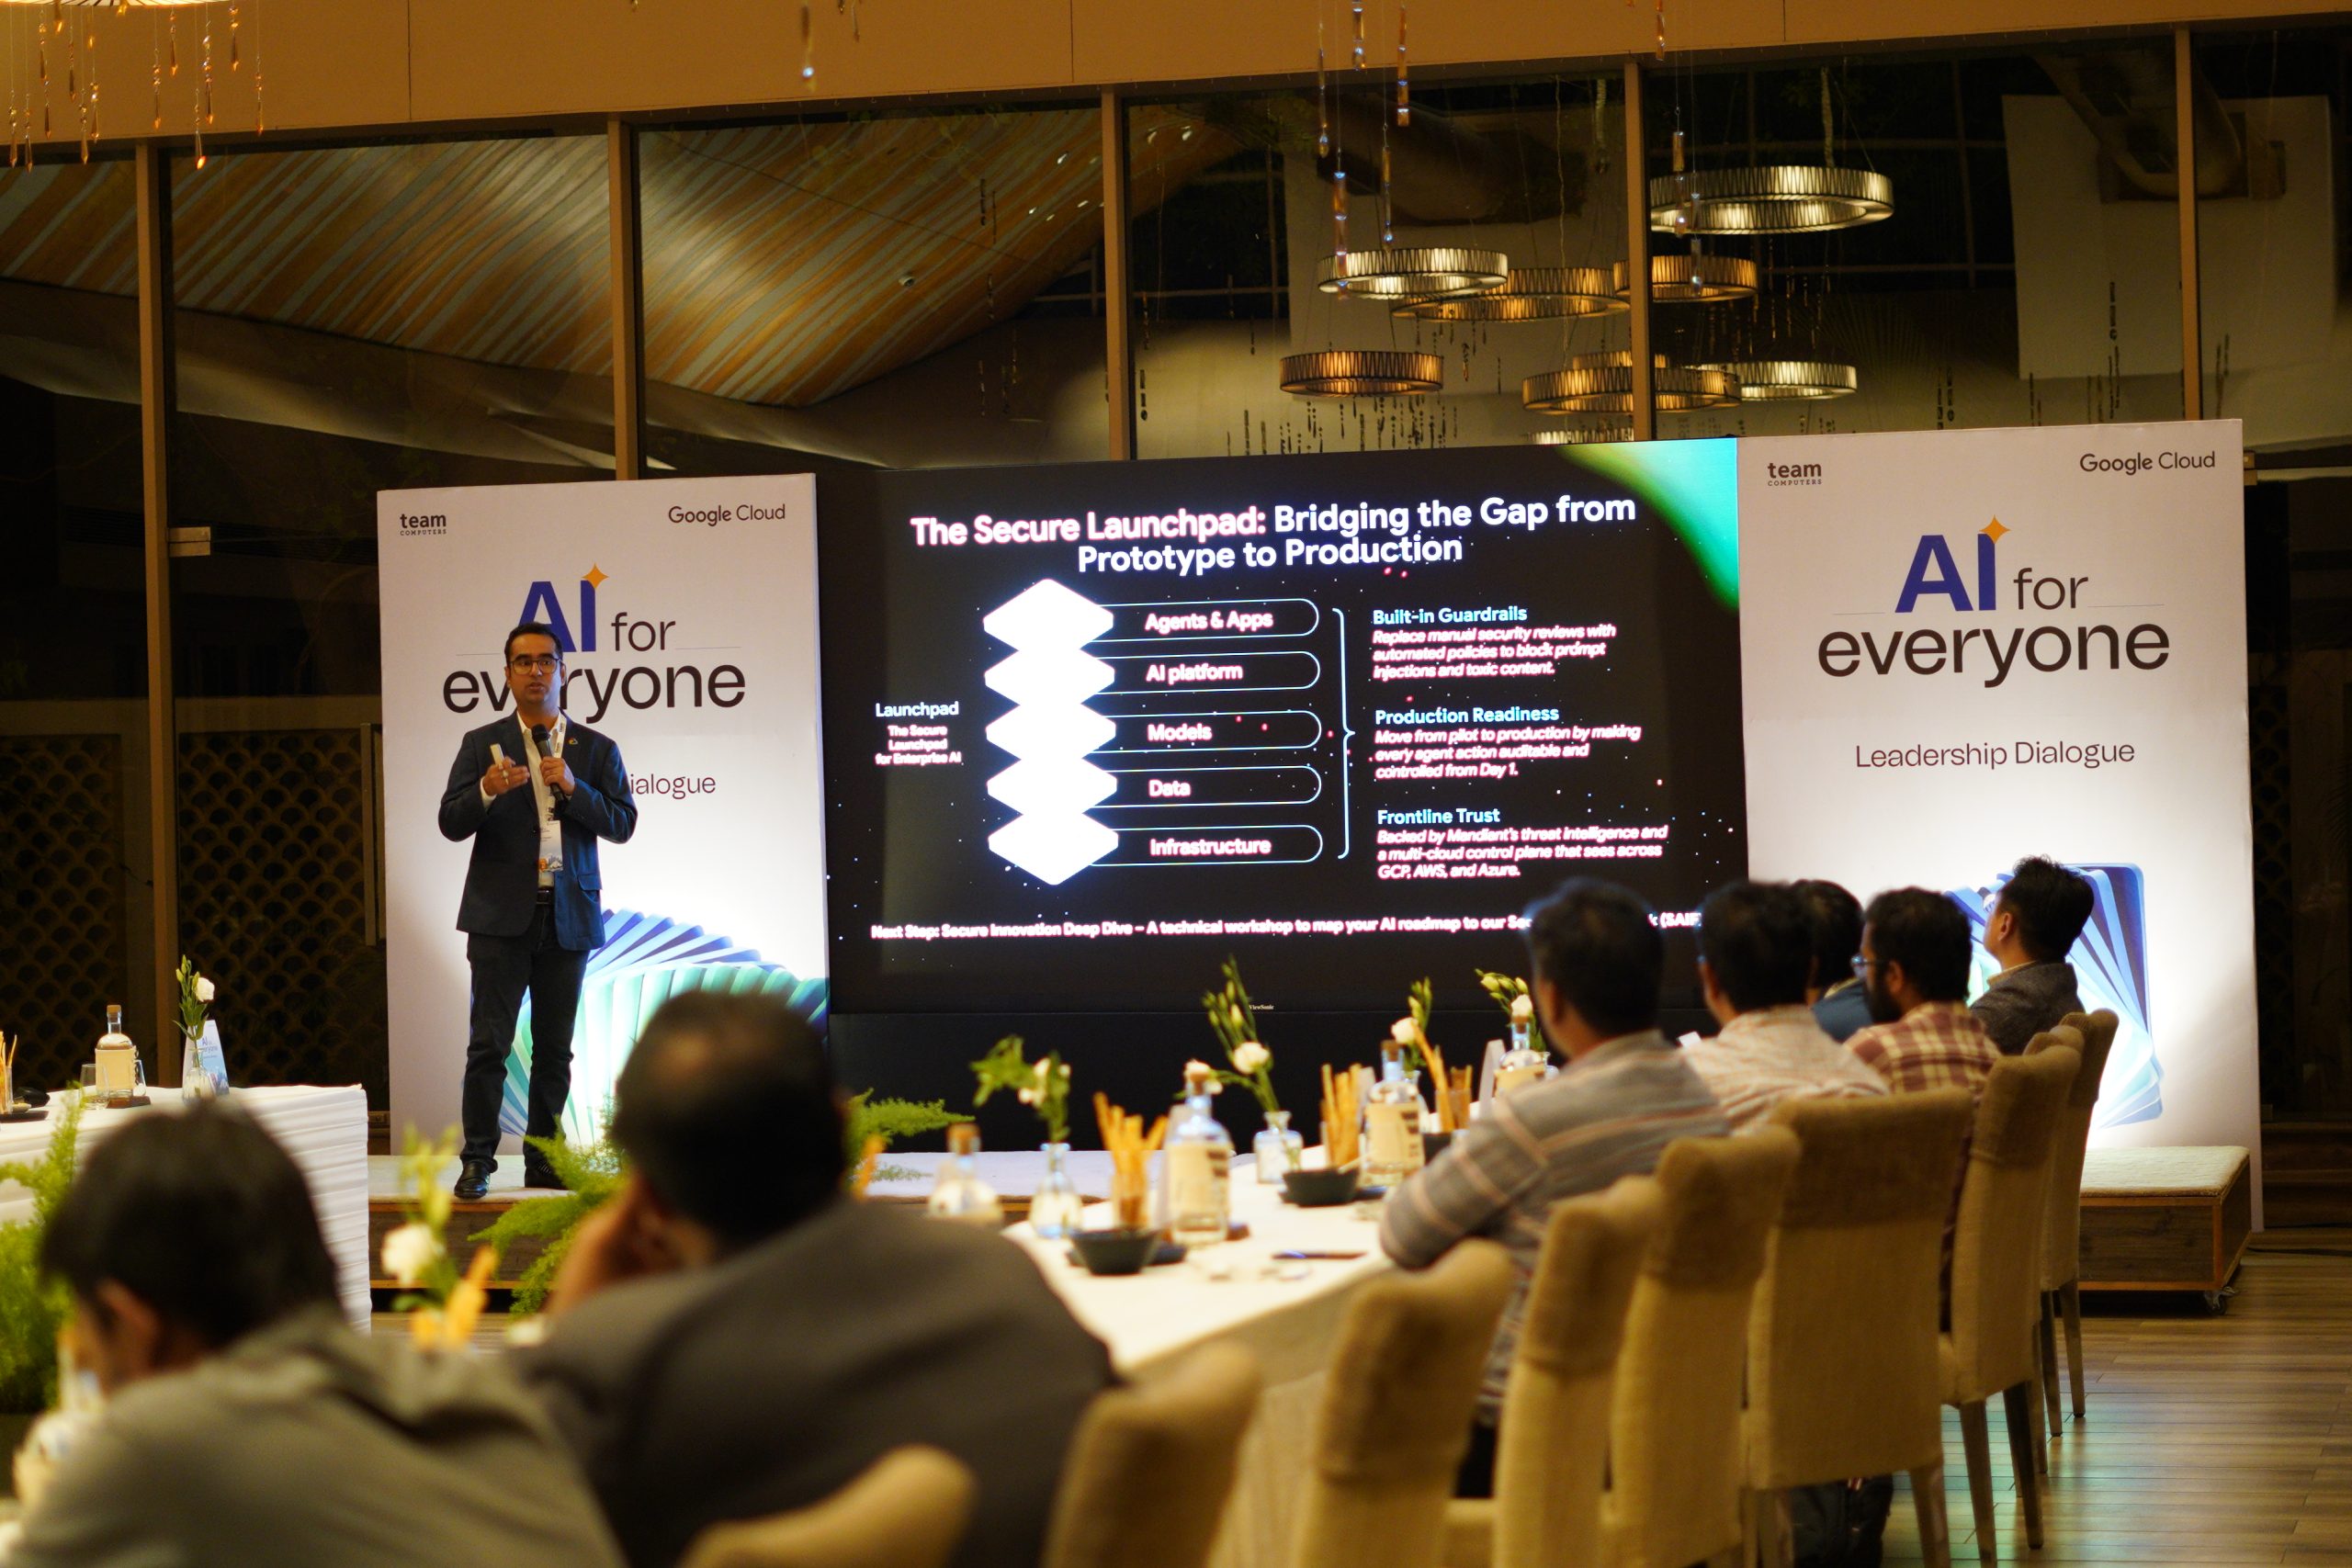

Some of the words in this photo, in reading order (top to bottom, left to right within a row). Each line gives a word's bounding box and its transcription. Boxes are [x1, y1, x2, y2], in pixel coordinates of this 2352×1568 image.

[1768, 462, 1822, 479] team
[2079, 453, 2154, 476] Google
[2158, 450, 2216, 470] Cloud
[1768, 479, 1822, 487] COMPUTERS
[400, 513, 447, 529] team
[668, 505, 731, 526] Google
[736, 503, 786, 522] Cloud
[910, 516, 970, 544] The
[974, 513, 1080, 544] Secure
[1087, 508, 1267, 544] Launchpad:
[1274, 502, 1409, 536] Bridging
[1418, 500, 1472, 527] the
[1480, 497, 1548, 531] Gap
[1555, 494, 1635, 523] from
[1078, 542, 1236, 576] Prototype
[1243, 544, 1277, 568] to
[1286, 532, 1463, 566] Production
[1894, 533, 1996, 614] AI
[2013, 567, 2088, 610] for
[518, 580, 597, 653] AI
[611, 612, 676, 652] for
[1145, 613, 1208, 635] Agents
[1209, 610, 1225, 629] &
[1226, 610, 1274, 632] Apps
[1373, 609, 1435, 626] Built-in
[1438, 605, 1528, 624] Guardrails
[1373, 629, 1426, 646] Replace
[1427, 627, 1477, 642] manual
[1477, 626, 1532, 642] security
[1532, 625, 1586, 640] reviews
[1586, 624, 1617, 637] with
[1373, 646, 1446, 662] automated
[1446, 645, 1498, 662] policies
[1499, 645, 1515, 659] to
[1516, 642, 1555, 658] block
[1555, 643, 1607, 660] prompt
[1818, 622, 2169, 688] everyone
[1146, 663, 1165, 682] AI
[1167, 662, 1244, 685] platform
[1374, 664, 1436, 682] injections
[1437, 663, 1464, 678] and
[1465, 662, 1498, 676] toxic
[1499, 660, 1555, 675] content.
[443, 662, 746, 724] evryone
[876, 700, 959, 719] Launchpad
[1375, 707, 1468, 725] Production
[1473, 705, 1560, 723] Readiness
[888, 724, 909, 737] The
[910, 724, 948, 737] Secure
[1147, 723, 1213, 741] Models
[1374, 729, 1413, 744] Move
[1414, 728, 1447, 743] from
[1448, 728, 1479, 745] pilot
[1480, 728, 1496, 741] to
[1496, 726, 1571, 744] production
[1572, 725, 1590, 741] by
[1591, 724, 1642, 742] making
[875, 752, 893, 765] for
[893, 752, 948, 767] Enterprise
[948, 750, 962, 763] AI
[1375, 748, 1414, 763] every
[1414, 746, 1454, 761] agent
[1455, 745, 1498, 761] action
[1498, 743, 1561, 759] auditable
[1562, 742, 1589, 758] and
[1856, 742, 2007, 771] Leadership
[2015, 739, 2135, 769] Dialogue
[1375, 764, 1443, 780] controlled
[1444, 763, 1478, 779] from
[1479, 761, 1507, 779] Day
[630, 773, 716, 800] ialogue
[1148, 779, 1192, 797] Data
[1377, 809, 1453, 825] Frontline
[1455, 807, 1500, 824] Trust
[1376, 829, 1427, 844] Backed
[1428, 829, 1446, 845] by
[1520, 826, 1562, 841] threat
[1563, 826, 1640, 843] intelligence
[1640, 825, 1668, 840] and
[1149, 837, 1272, 856] Infrastructure
[1377, 850, 1387, 862] a
[1465, 845, 1515, 861] control
[1514, 844, 1553, 862] plane
[1555, 843, 1583, 858] that
[1583, 844, 1617, 858] sees
[1617, 844, 1663, 858] across
[1449, 863, 1479, 878] and
[871, 924, 904, 939] Next
[941, 924, 989, 938] Secure
[989, 922, 1062, 937] Innovation
[1063, 921, 1101, 938] Deep
[1102, 921, 1134, 936] Dive
[1146, 920, 1159, 935] A
[1159, 920, 1223, 935] technical
[1224, 919, 1294, 936] workshop
[1295, 919, 1311, 933] to
[1312, 920, 1344, 936] map
[1344, 919, 1379, 934] your
[1379, 917, 1396, 931] AI
[1397, 917, 1461, 933] roadmap
[1463, 917, 1479, 931] to
[1480, 916, 1507, 931] our
